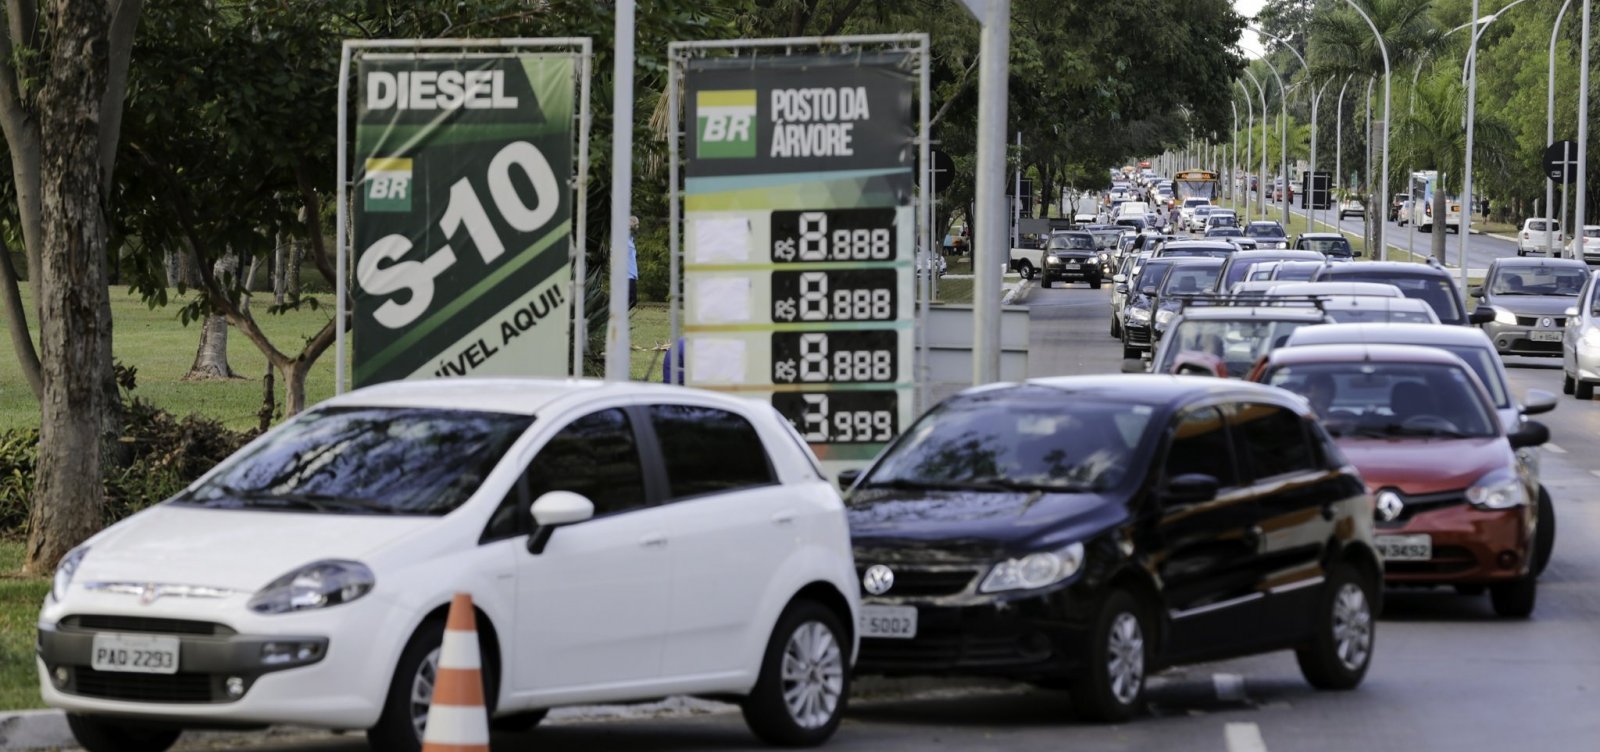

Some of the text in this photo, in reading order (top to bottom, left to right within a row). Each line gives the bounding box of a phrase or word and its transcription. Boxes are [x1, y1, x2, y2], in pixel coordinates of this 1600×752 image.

[366, 70, 518, 111] DIESEL
[771, 87, 869, 122] POSTO DA
[703, 115, 751, 142] BR
[770, 119, 854, 158] ÁRVORE
[369, 176, 407, 199] BR
[356, 140, 560, 329] S-10
[774, 212, 890, 262] R$ 8.888
[775, 272, 891, 322] R$ 8.888
[434, 283, 566, 378] ÍVEL AQUI!
[775, 333, 891, 383] R$ 8.888
[871, 617, 911, 633] 5002
[133, 651, 173, 668] 2293
